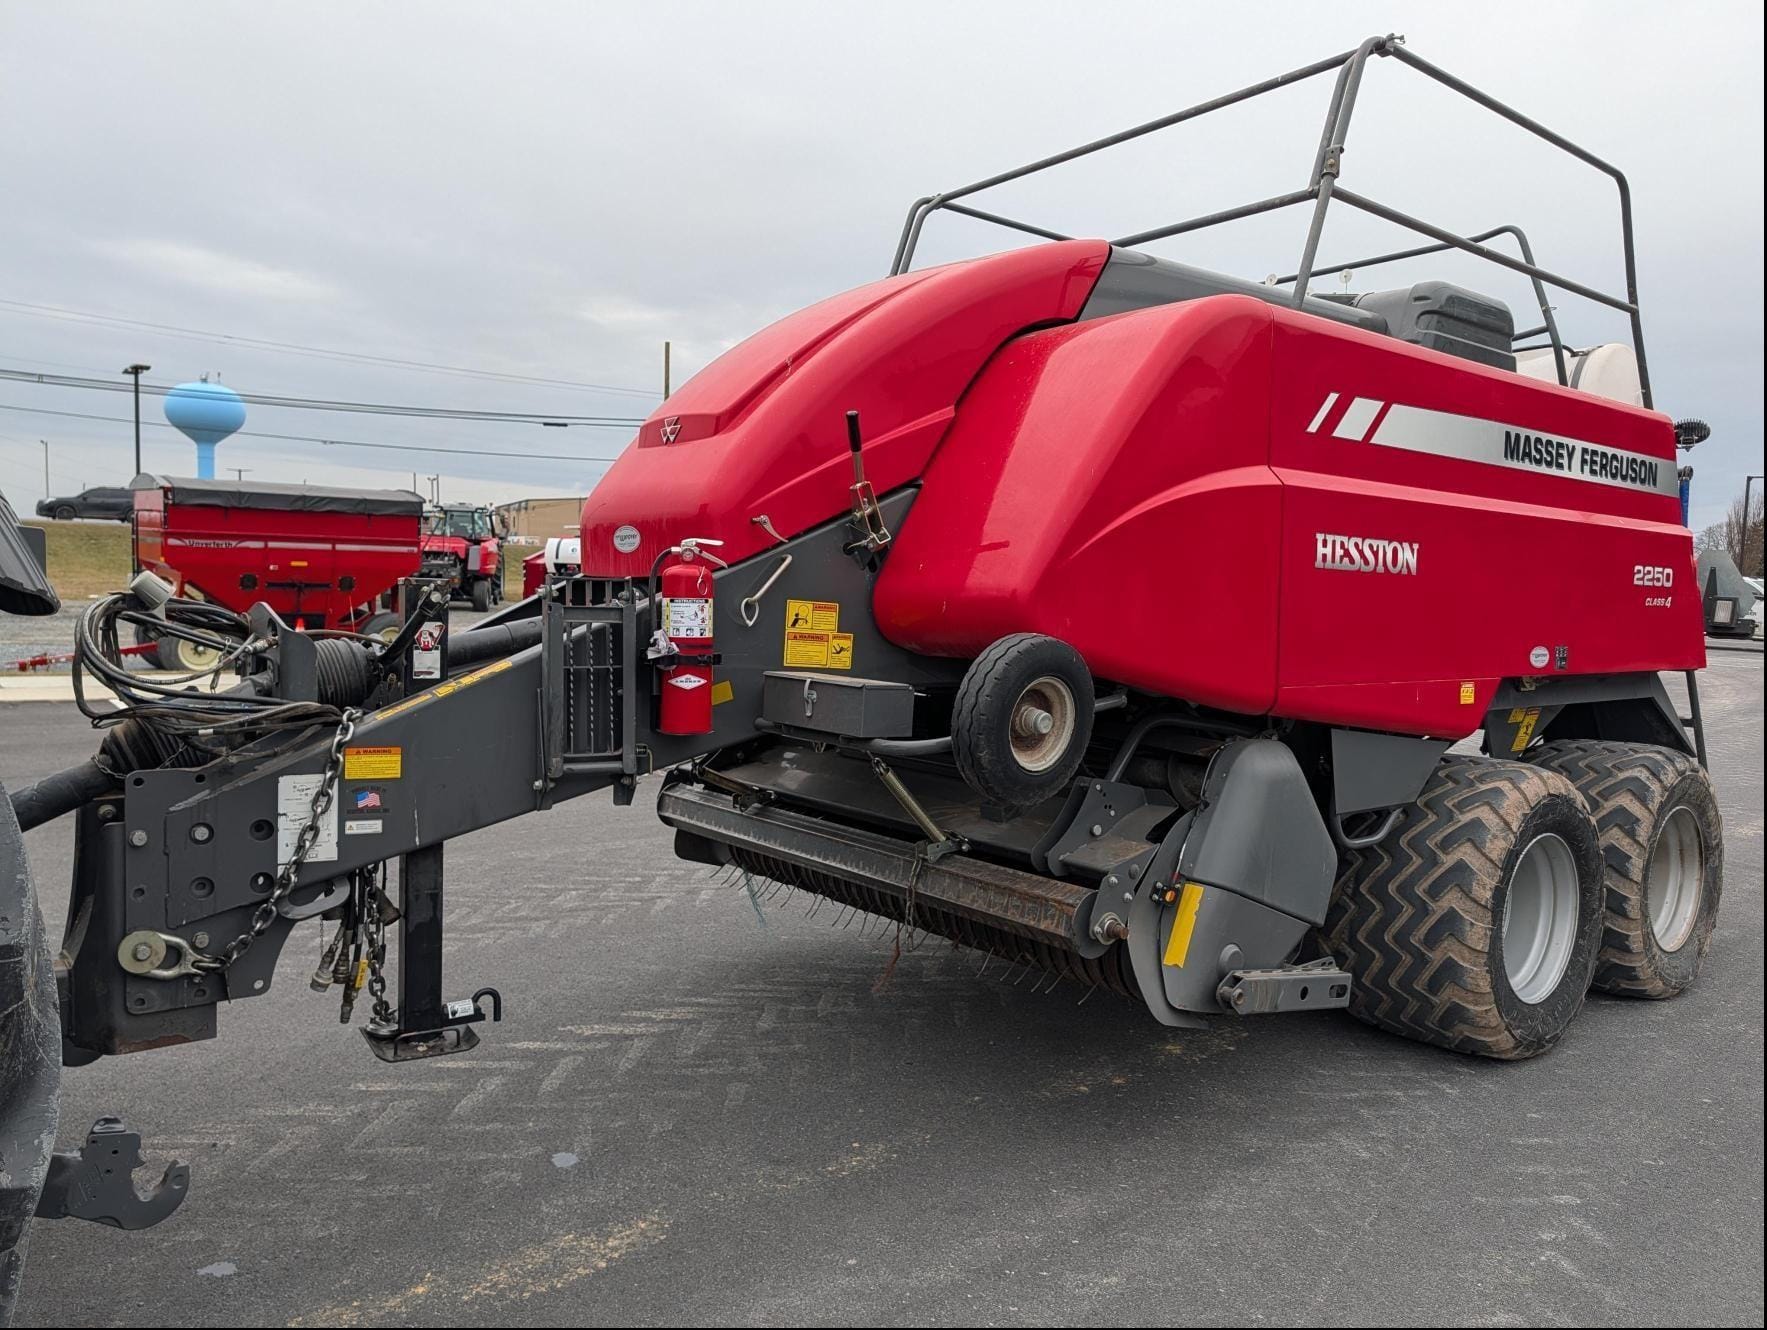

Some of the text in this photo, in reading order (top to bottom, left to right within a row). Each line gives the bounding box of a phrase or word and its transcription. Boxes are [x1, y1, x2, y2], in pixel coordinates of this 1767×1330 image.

[1504, 430, 1658, 488] MASSEY FERGUSON
[1315, 533, 1419, 575] HESSTON
[1634, 565, 1673, 588] 2250
[1645, 596, 1672, 608] CLASS 4
